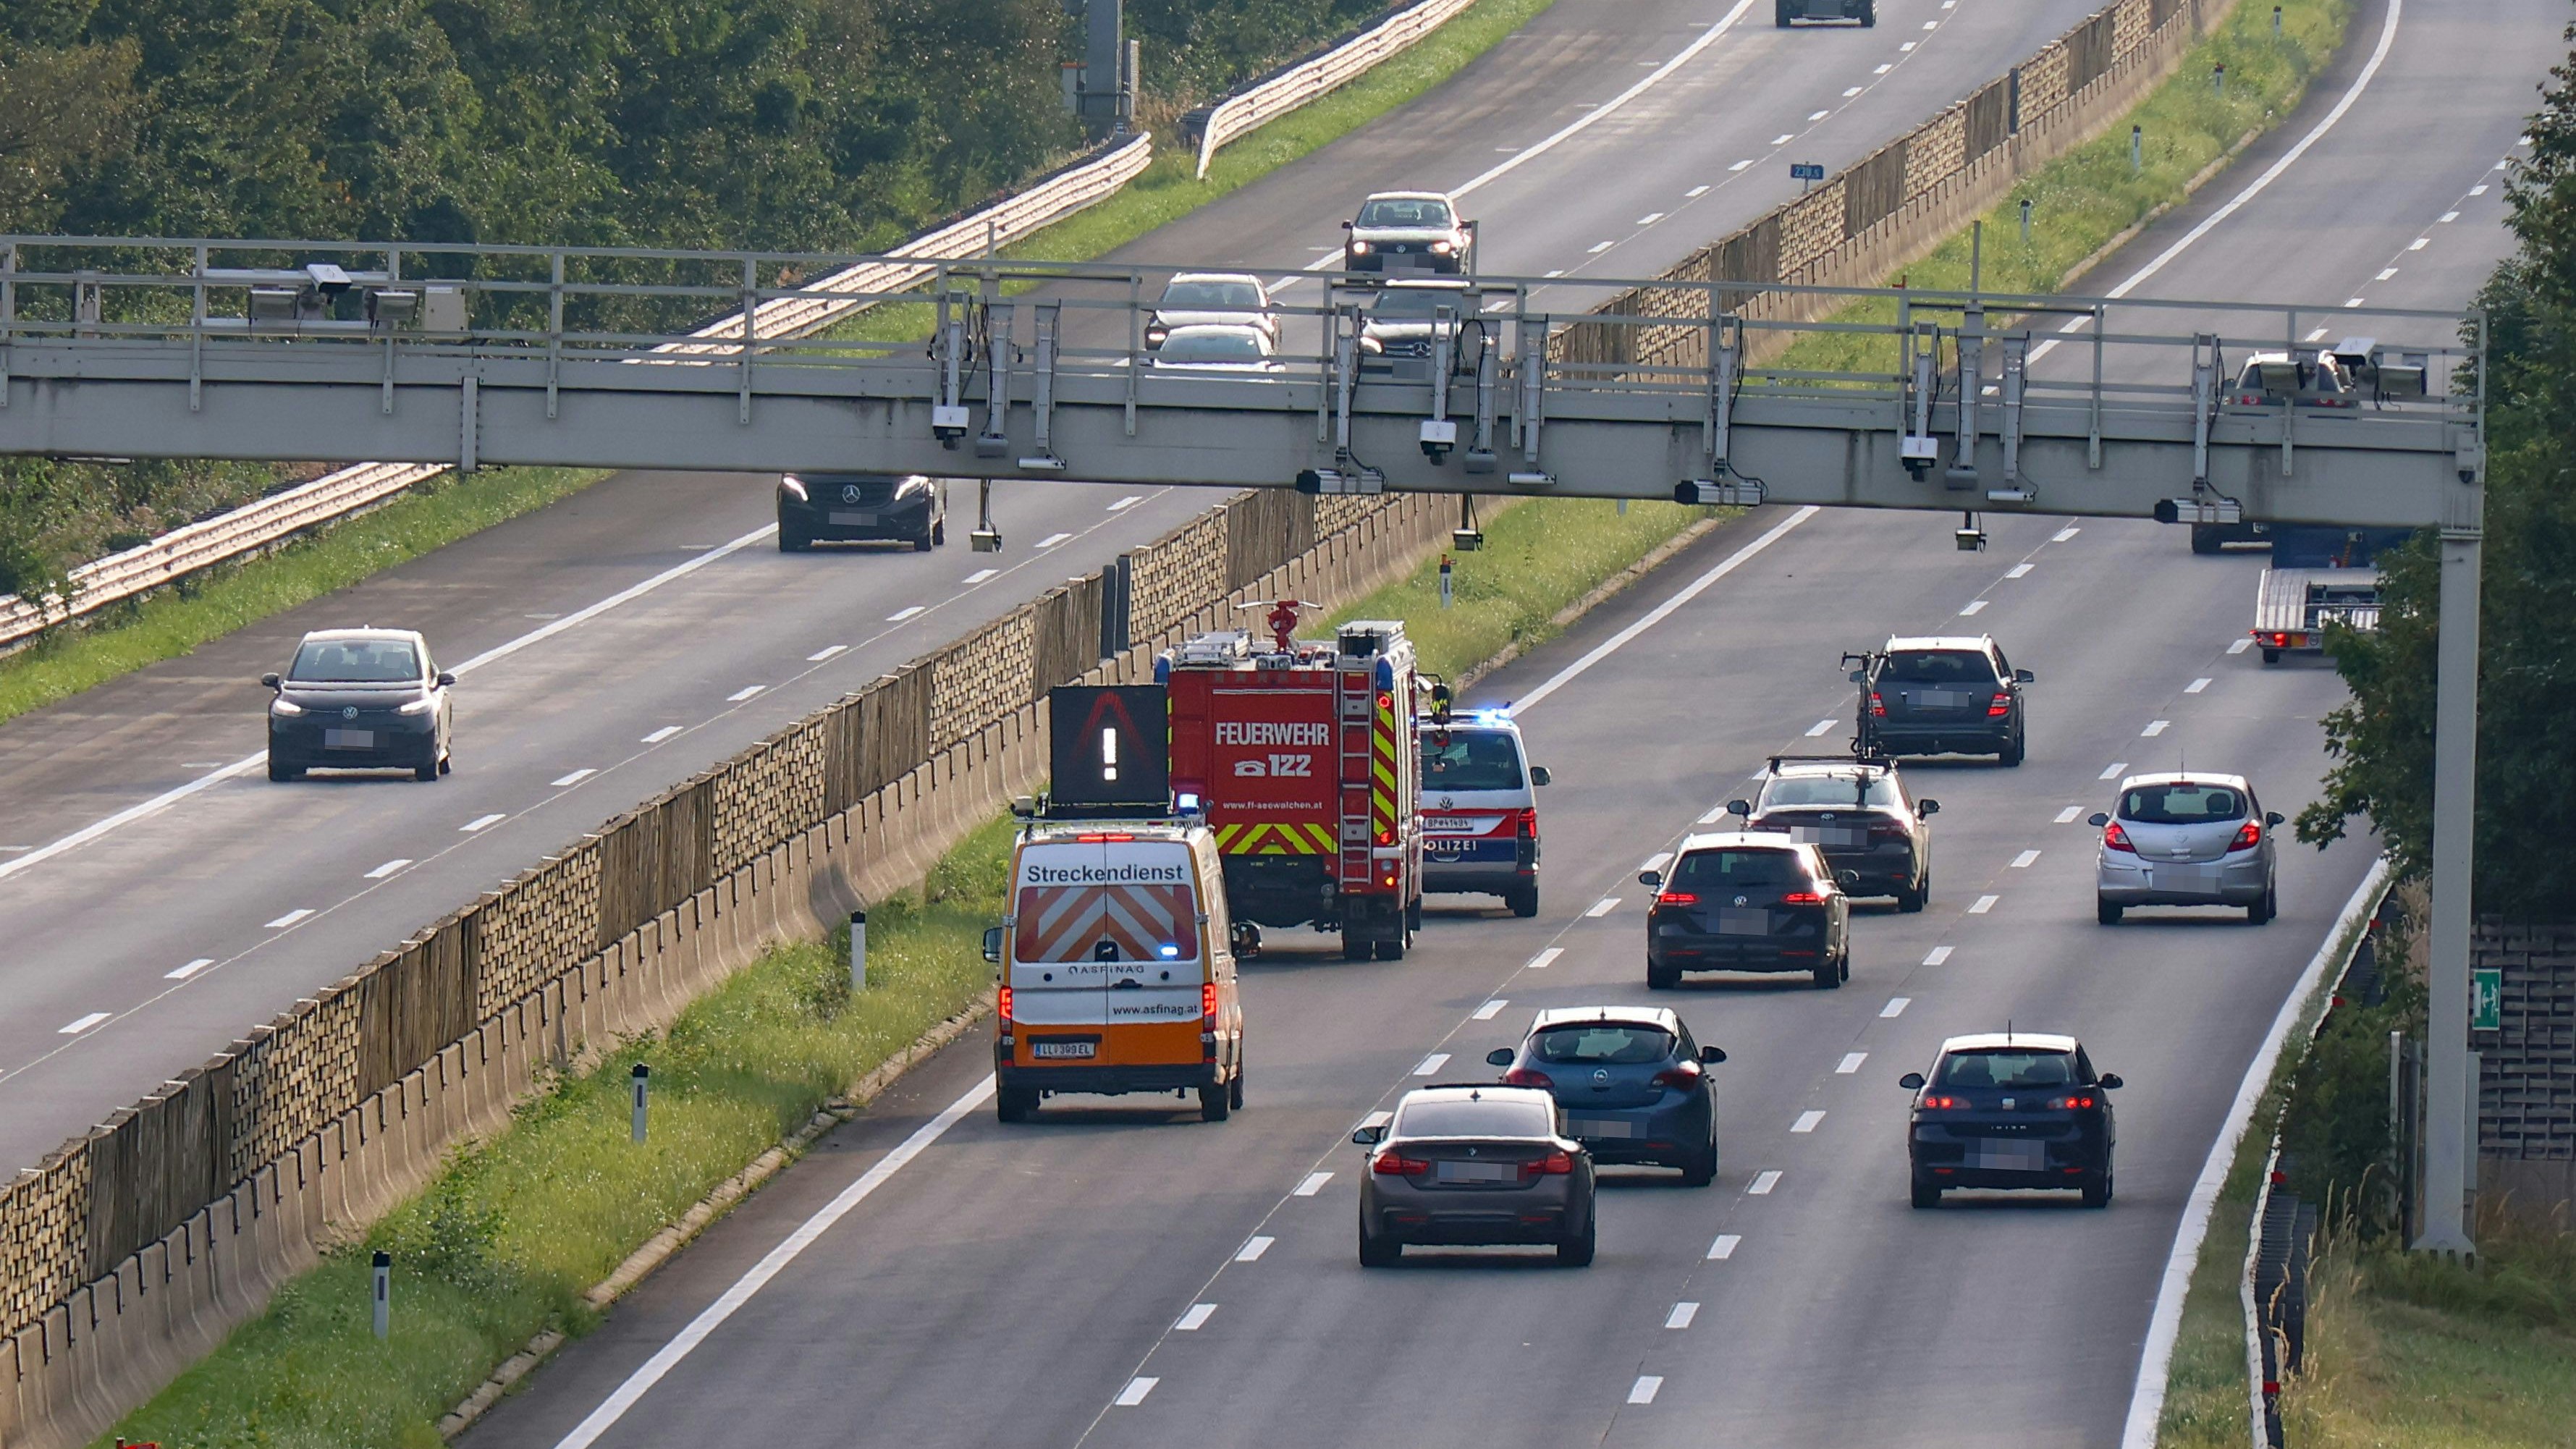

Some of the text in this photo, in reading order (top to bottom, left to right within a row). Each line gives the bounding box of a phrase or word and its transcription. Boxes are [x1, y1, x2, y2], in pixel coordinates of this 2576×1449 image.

[1215, 722, 1330, 746] FEUERWEHR
[1268, 753, 1312, 777] 122
[1222, 800, 1323, 810] www.ff-seewalchen.at
[1424, 840, 1477, 851] OLIZEI
[1027, 863, 1183, 883] Streckendienst
[1112, 1003, 1198, 1015] www.asfinag.at
